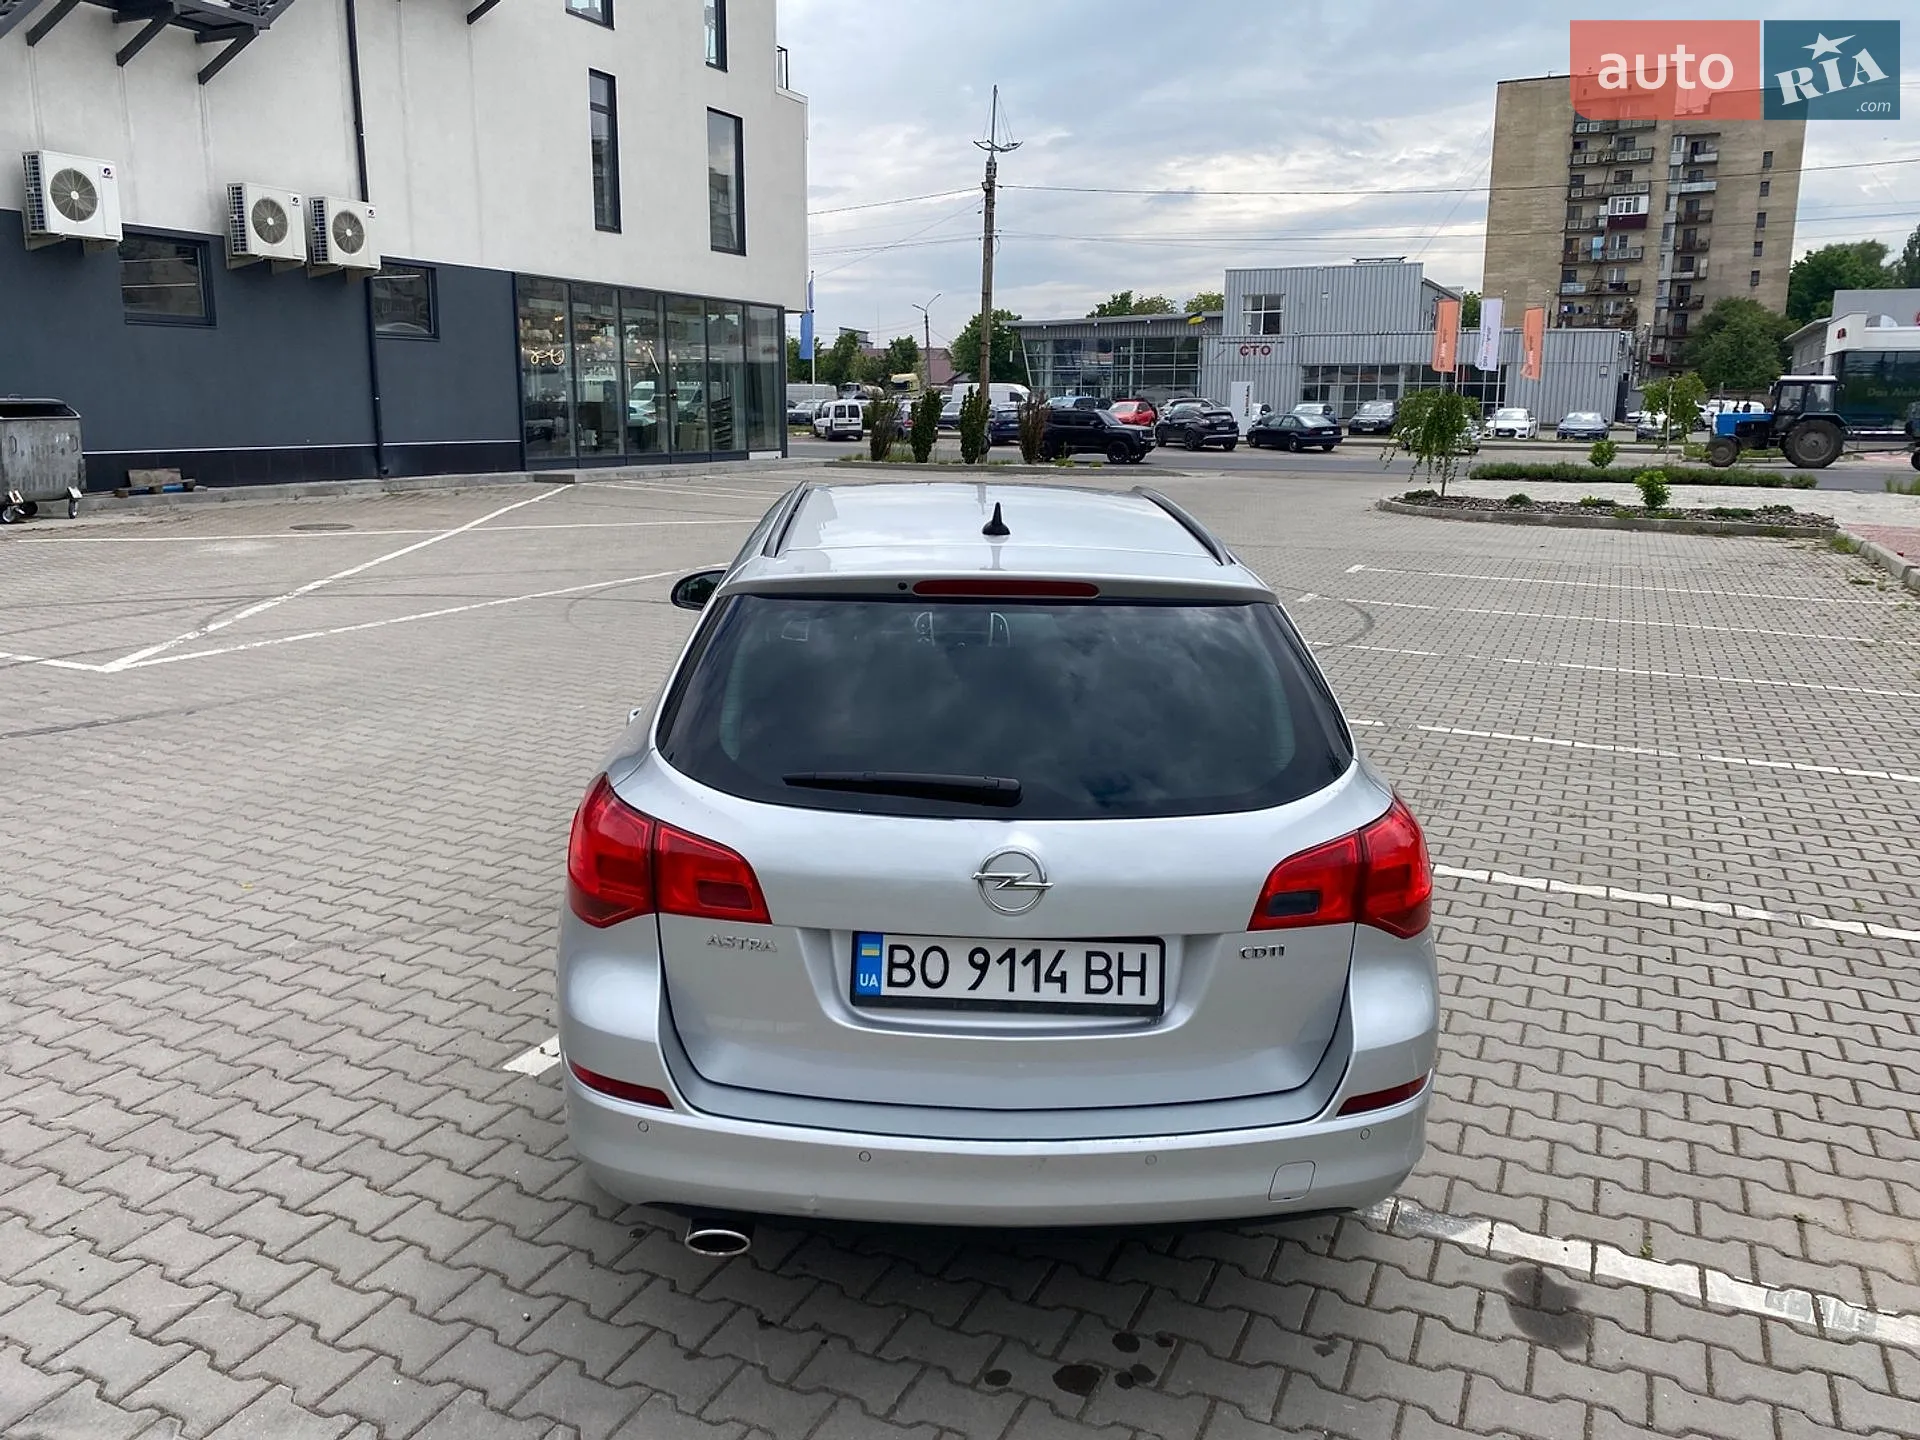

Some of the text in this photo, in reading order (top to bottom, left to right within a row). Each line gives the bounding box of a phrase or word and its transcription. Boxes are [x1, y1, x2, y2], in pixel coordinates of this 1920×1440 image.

[1239, 345, 1272, 356] СТО
[705, 934, 778, 953] ASTRA
[1240, 944, 1287, 960] CDTI
[886, 944, 1148, 997] BO 9114 BH
[860, 973, 879, 988] UA
